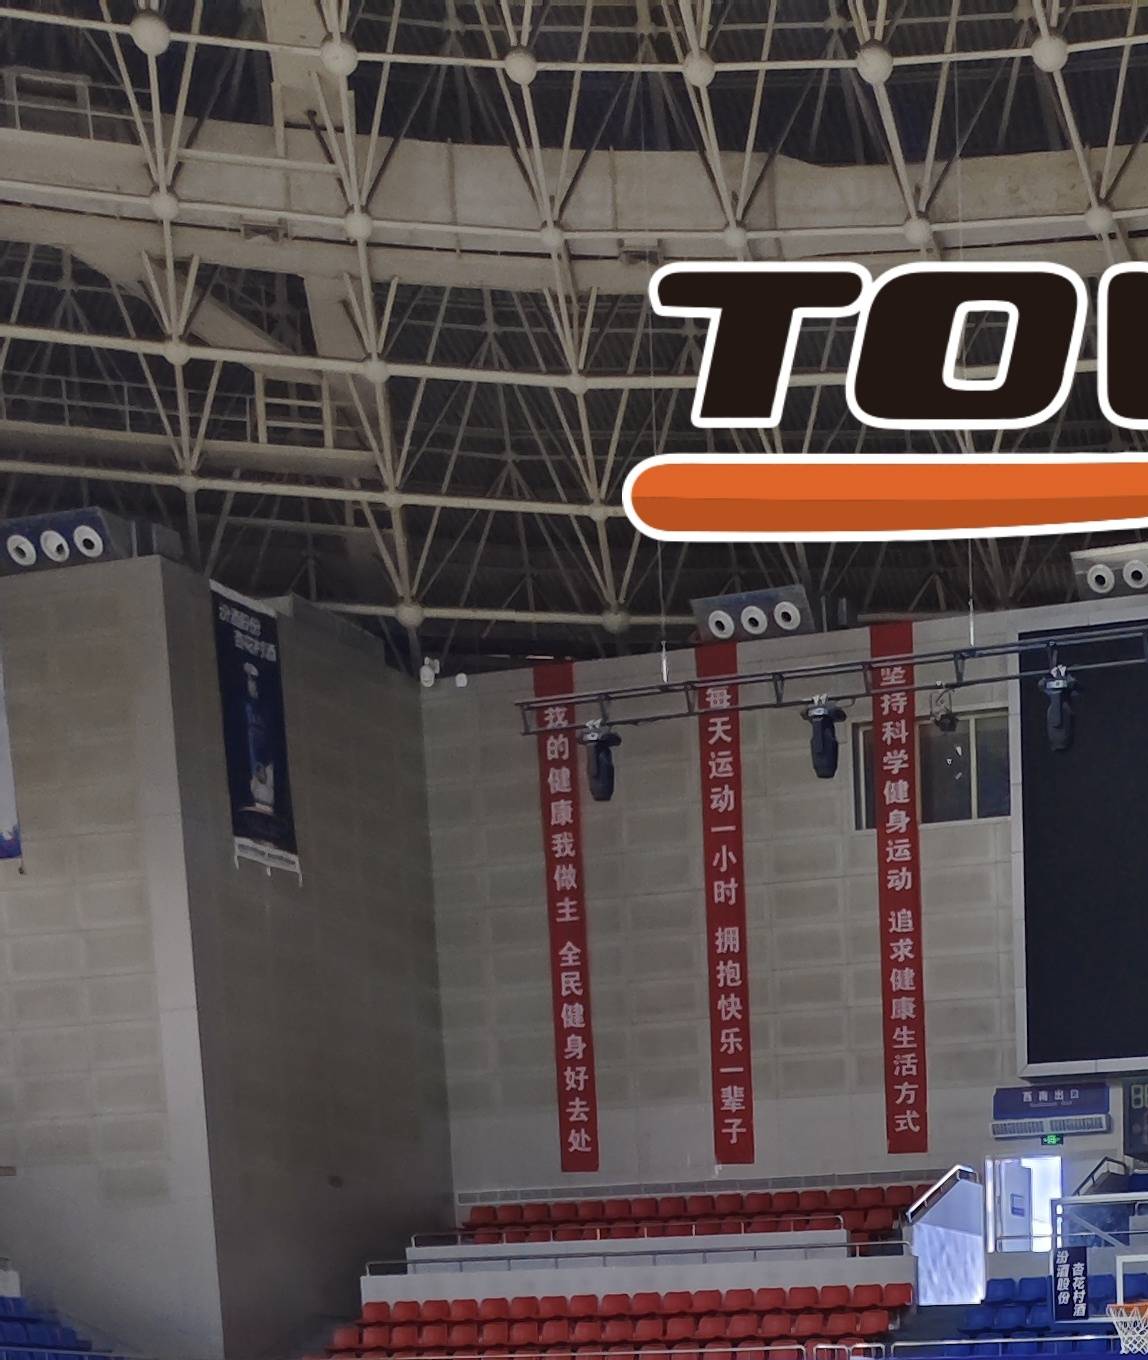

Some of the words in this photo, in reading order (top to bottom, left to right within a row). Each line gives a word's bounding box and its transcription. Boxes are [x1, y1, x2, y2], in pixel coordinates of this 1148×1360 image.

[544, 707, 579, 922] 我的健康我做主
[706, 687, 738, 905] 每天运动一小时
[880, 667, 912, 891] 坚持科学健身运动
[558, 941, 592, 1152] 全民健身好去处
[715, 926, 746, 1144] 拥抱快乐一辈子
[888, 908, 920, 1133] 追求健康生活方式
[1056, 1250, 1070, 1304] 汾酒股份
[1072, 1262, 1086, 1316] 杏花村酒
